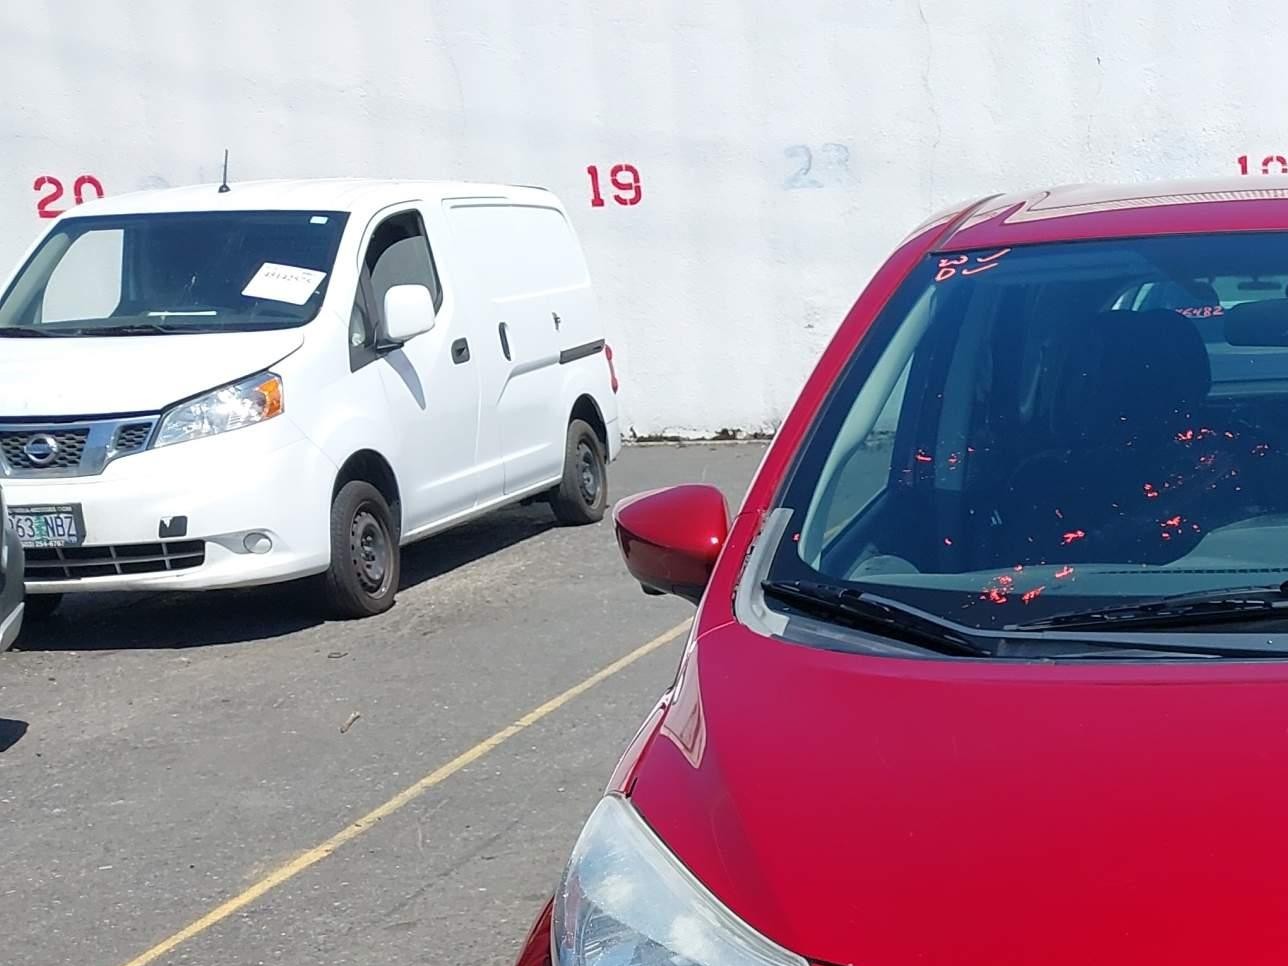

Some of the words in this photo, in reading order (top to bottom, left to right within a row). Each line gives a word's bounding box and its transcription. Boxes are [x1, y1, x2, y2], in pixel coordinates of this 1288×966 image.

[33, 175, 104, 218] 20
[587, 164, 642, 206] 19
[44, 516, 77, 537] NBZ
